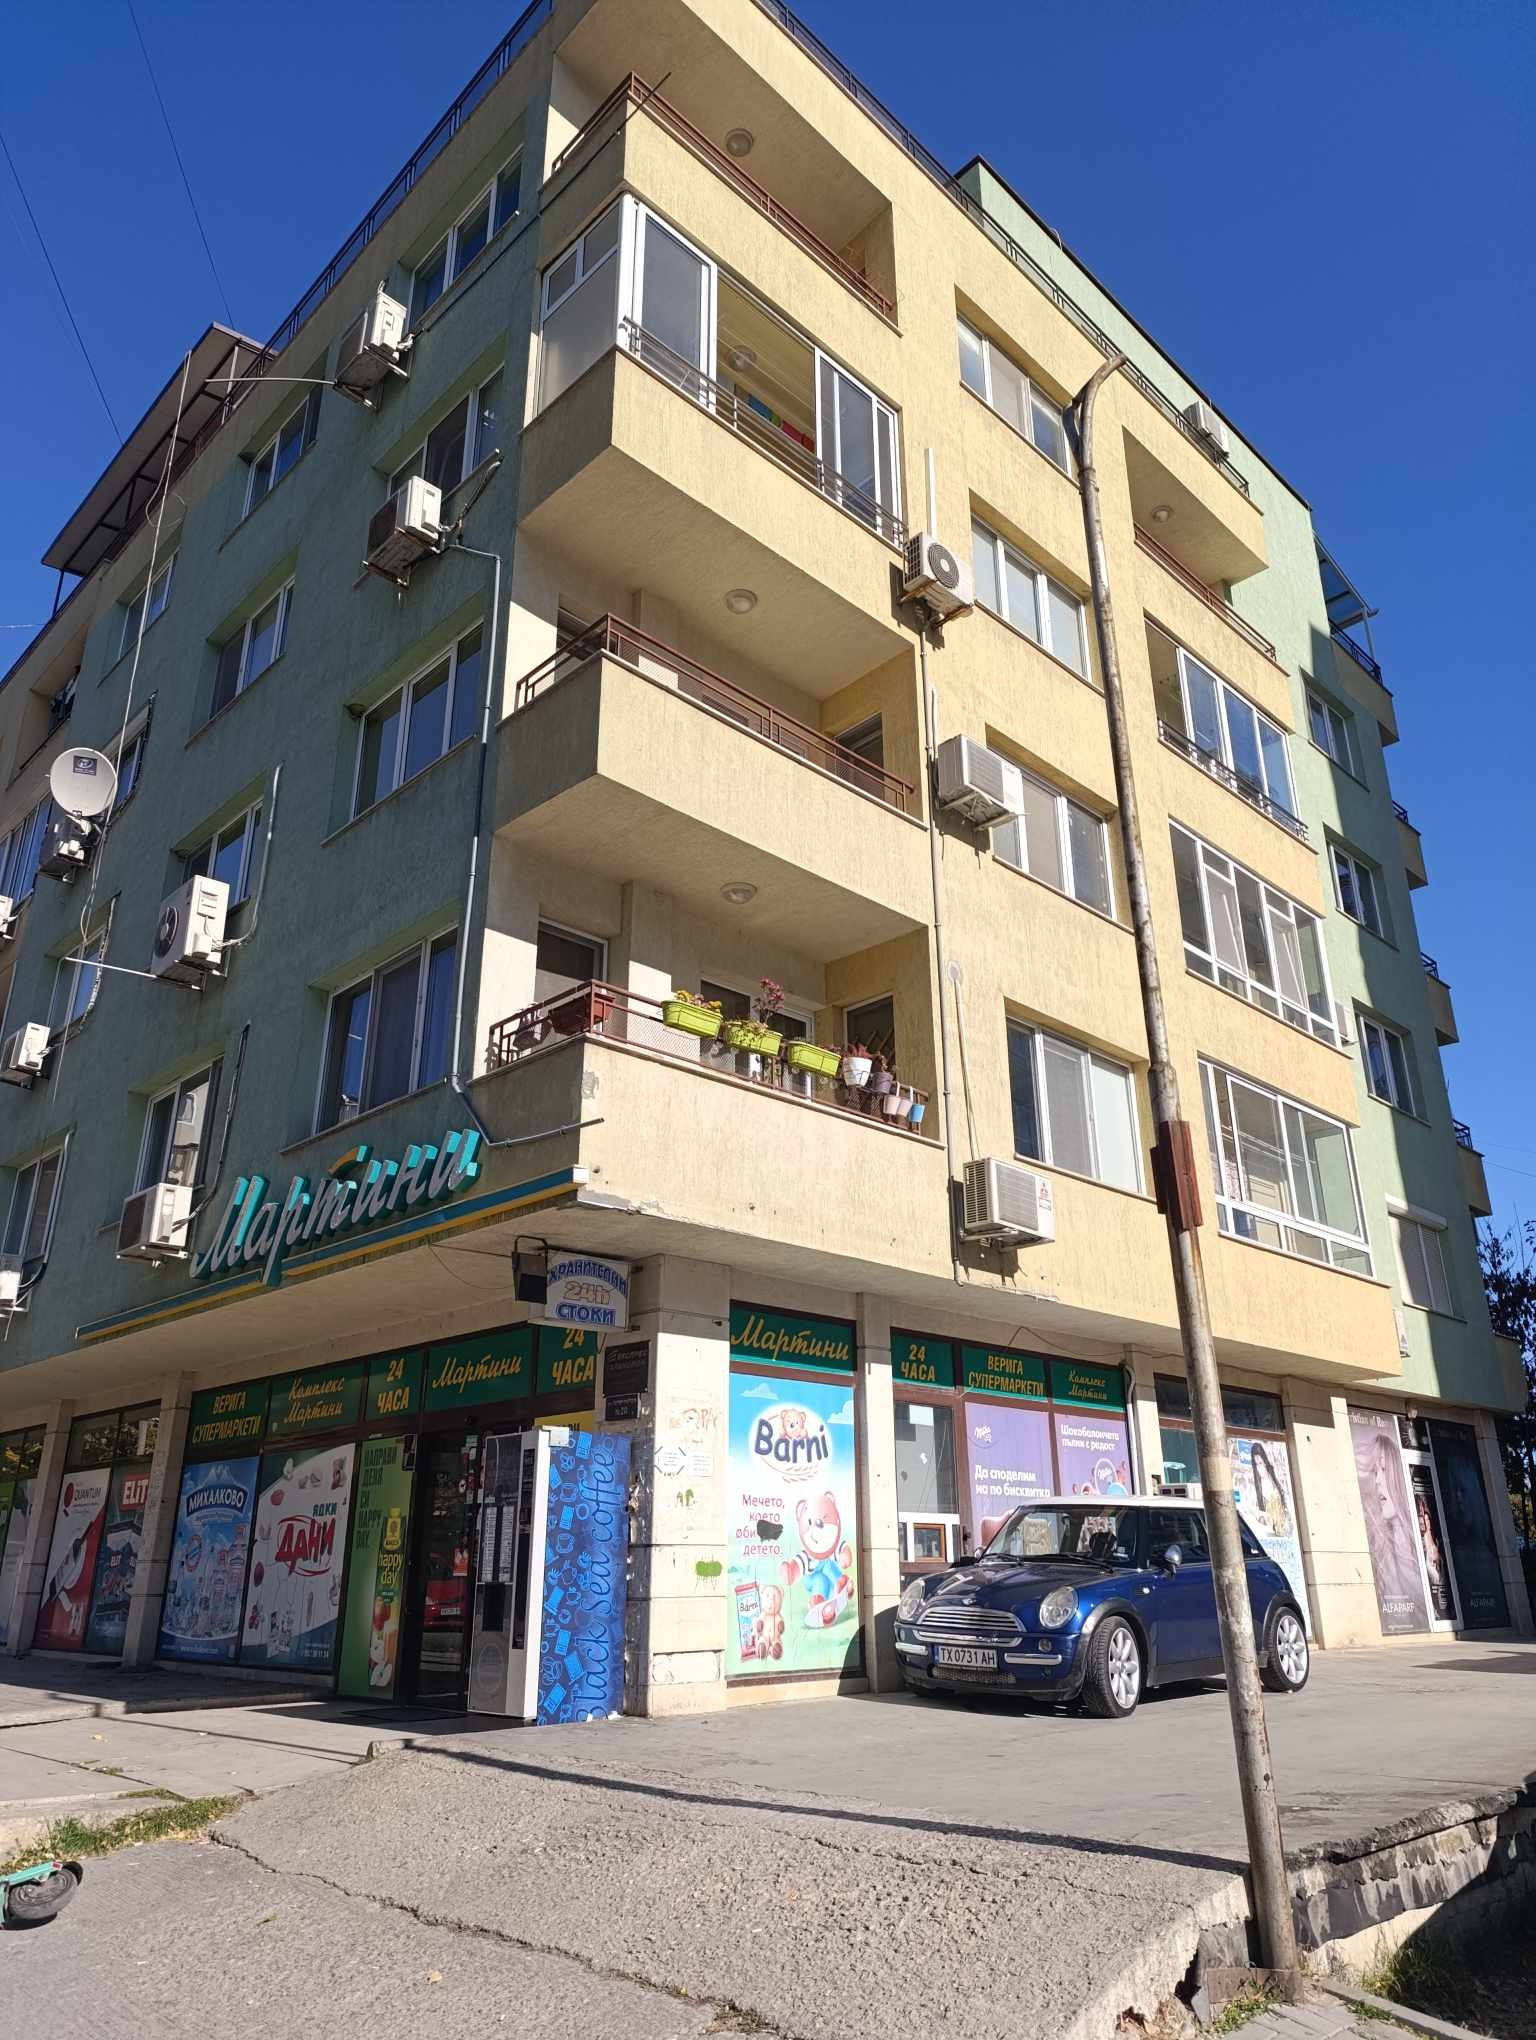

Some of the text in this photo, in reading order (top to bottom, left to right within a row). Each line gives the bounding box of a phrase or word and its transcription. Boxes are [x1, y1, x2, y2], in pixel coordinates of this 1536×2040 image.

[189, 1129, 481, 1286] Мартини
[549, 1259, 627, 1297] ХРАНИТЕЛНИ
[556, 1302, 616, 1326] СТОКИ
[562, 1327, 585, 1349] 24
[731, 1313, 849, 1361] Мартини
[908, 1343, 926, 1361] 24
[386, 1358, 405, 1382] 24
[432, 1354, 523, 1393] Мартини
[552, 1356, 595, 1386] ЧАСА
[901, 1361, 936, 1382] ЧАСА
[988, 1355, 1024, 1375] ВЕРИГА
[288, 1377, 345, 1401] Комплекс
[968, 1371, 1044, 1396] СУПЕРМАРКЕТИ
[1068, 1370, 1106, 1387] Комплекс
[212, 1391, 247, 1415] ВЕРИГА
[377, 1386, 411, 1414] ЧАСА
[1068, 1386, 1108, 1401] Мартини
[284, 1399, 343, 1427] Мартини
[192, 1415, 262, 1444] СУПЕРМАРКЕТИ
[1061, 1424, 1120, 1441] Шокобалончета
[755, 1418, 829, 1464] Barni
[1062, 1438, 1085, 1449] пълни
[1090, 1441, 1115, 1451] радост
[974, 1464, 1036, 1482] Да споделим
[74, 1487, 102, 1501] QUANTUM
[188, 1489, 245, 1512] МИХАЛКОВО
[579, 1449, 620, 1543] coffee
[976, 1482, 1051, 1498] на по бисквитка
[312, 1502, 338, 1517] ЯДКИ
[742, 1493, 785, 1509] Мечето,
[749, 1511, 781, 1522] което
[275, 1518, 336, 1571] ДАНИ
[743, 1544, 783, 1556] детето.
[379, 1551, 403, 1571] happy
[381, 1567, 398, 1588] day
[739, 1602, 759, 1612] Barni
[1383, 1601, 1415, 1613] ALFAPARF
[940, 1647, 996, 1665] TX 0731 AH
